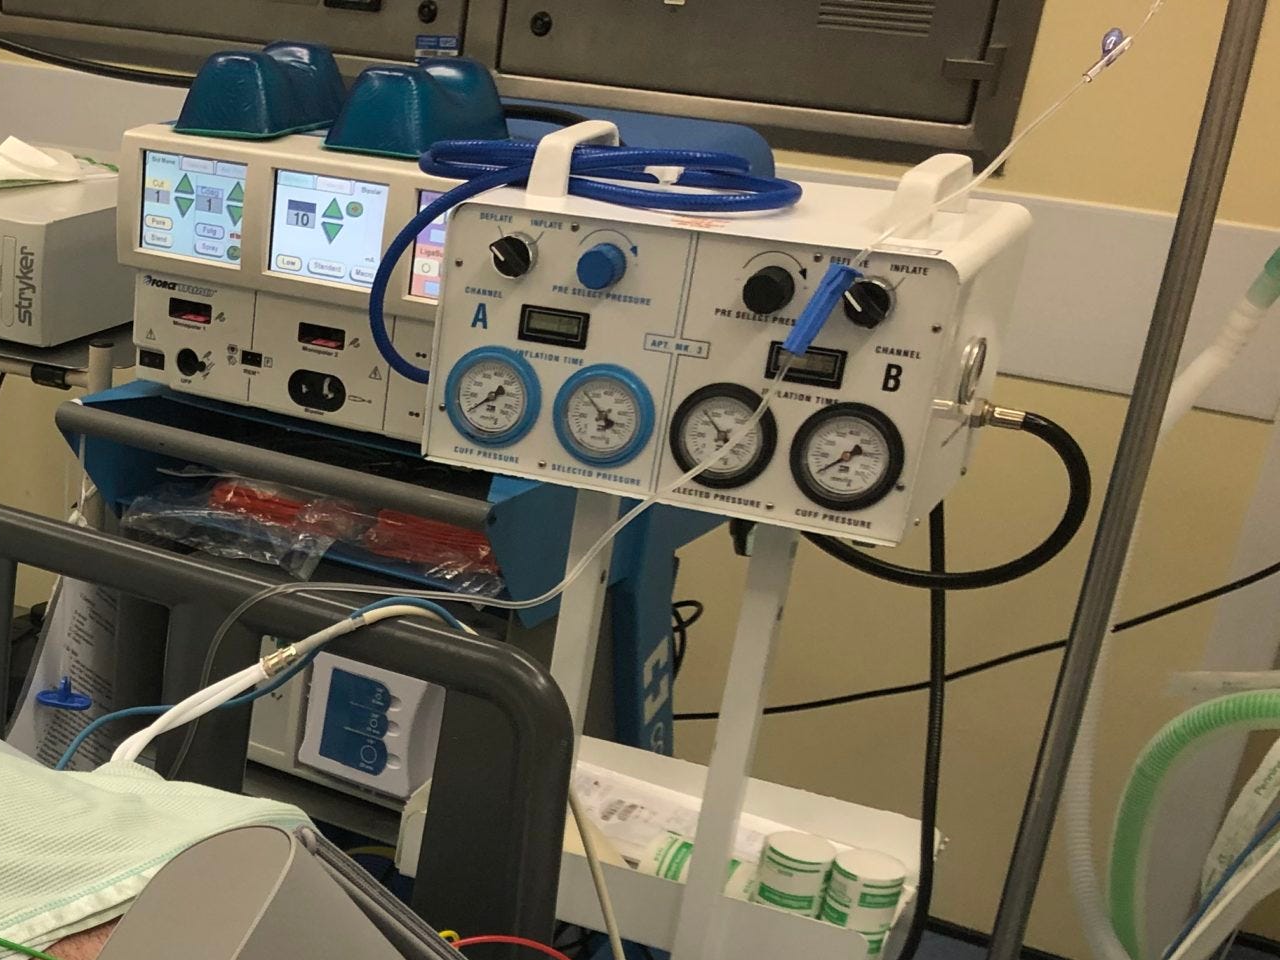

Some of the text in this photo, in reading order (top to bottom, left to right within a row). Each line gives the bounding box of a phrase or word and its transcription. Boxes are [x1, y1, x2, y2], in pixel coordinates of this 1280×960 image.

[152, 180, 165, 188] Cut
[155, 191, 160, 203] 1
[207, 199, 212, 212] 1
[294, 212, 310, 226] 10
[480, 212, 563, 230] DEFLATE INFLATE
[890, 264, 929, 276] INFLATE
[15, 245, 36, 327] stryker
[465, 286, 502, 298] CHANNEL
[552, 285, 651, 306] PRE SELECT PRESSURE
[471, 303, 487, 329] A
[715, 308, 731, 317] PRE
[736, 311, 768, 323] SELECT
[651, 340, 668, 349] APT
[875, 346, 921, 360] CHANNEL
[564, 356, 584, 366] TIME
[882, 363, 903, 392] B
[454, 446, 519, 464] CUFF PRESSURE
[551, 463, 640, 486] SELECTED PRESSURE
[713, 493, 761, 509] PRESSURE
[795, 508, 872, 529] CUFF PRESSURE
